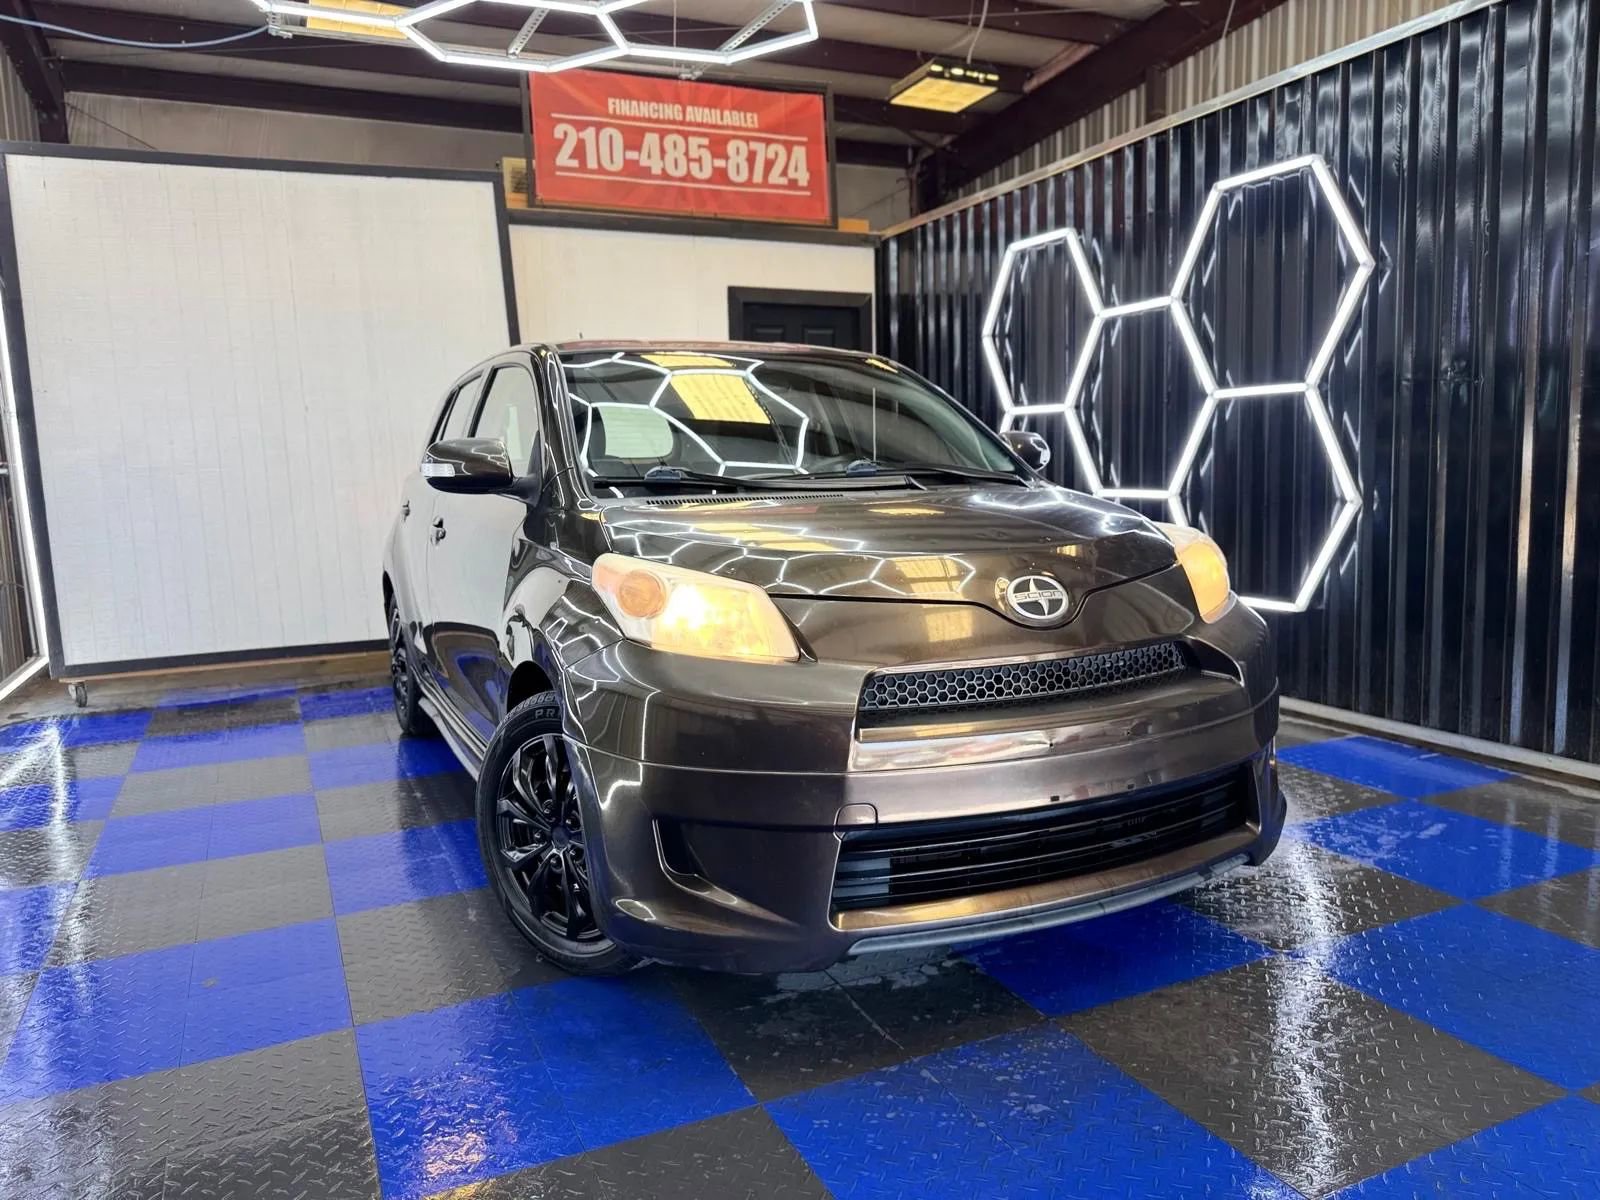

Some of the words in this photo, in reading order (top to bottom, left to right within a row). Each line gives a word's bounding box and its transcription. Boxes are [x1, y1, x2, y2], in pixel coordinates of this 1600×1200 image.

[608, 97, 683, 121] FINANCING
[685, 105, 759, 128] AVAILABLE!
[553, 123, 810, 187] 210-485-8724
[534, 708, 559, 719] PR
